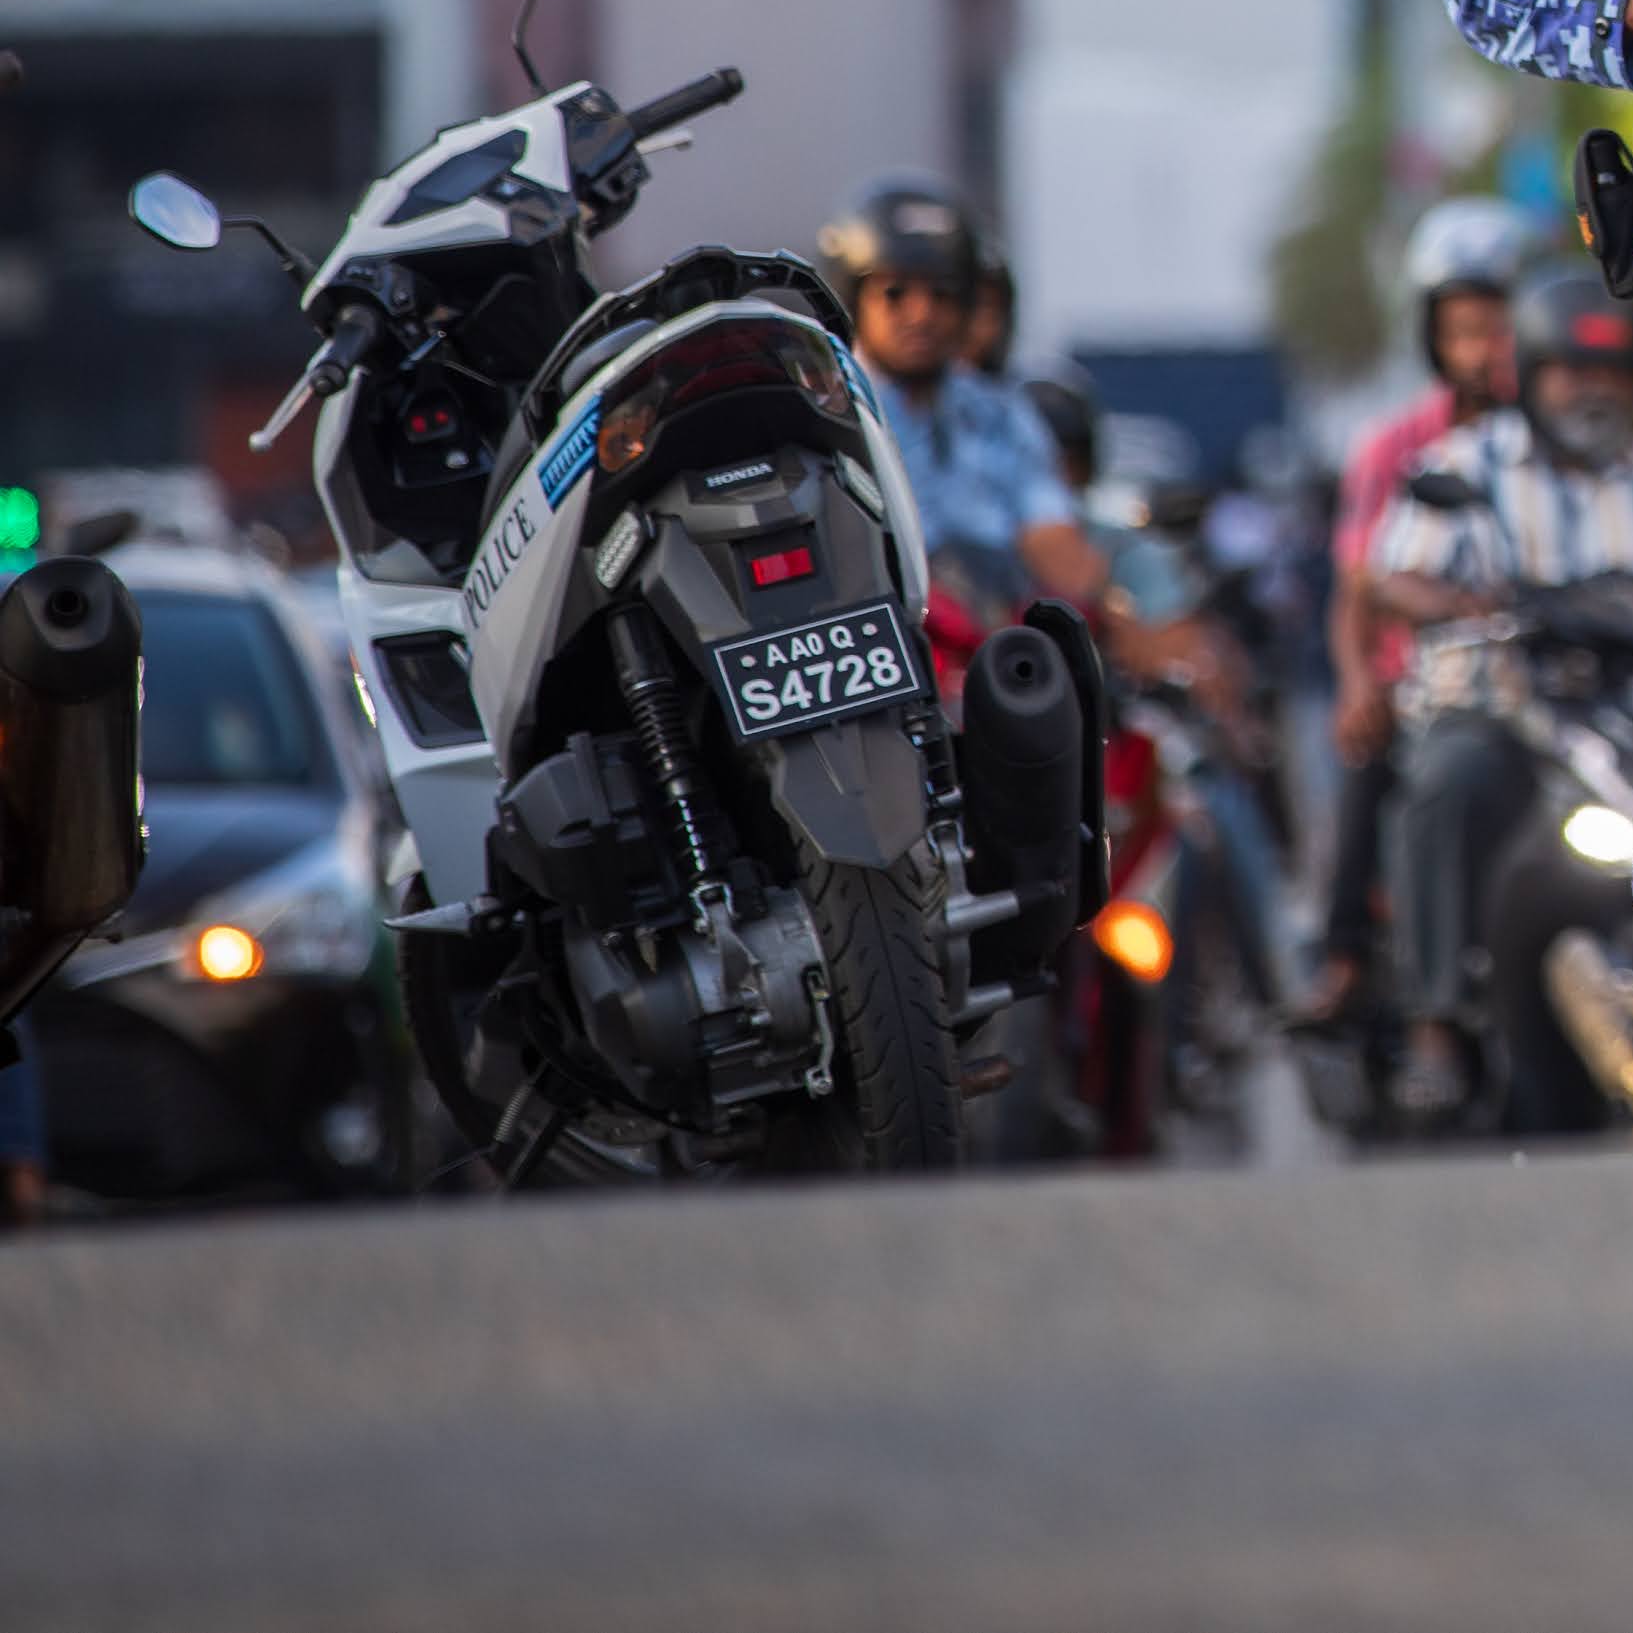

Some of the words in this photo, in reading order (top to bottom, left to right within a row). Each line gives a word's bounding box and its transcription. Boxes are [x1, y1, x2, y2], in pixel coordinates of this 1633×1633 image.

[706, 462, 774, 488] HONDA
[463, 497, 536, 630] POLICE
[740, 646, 902, 721] S4728
